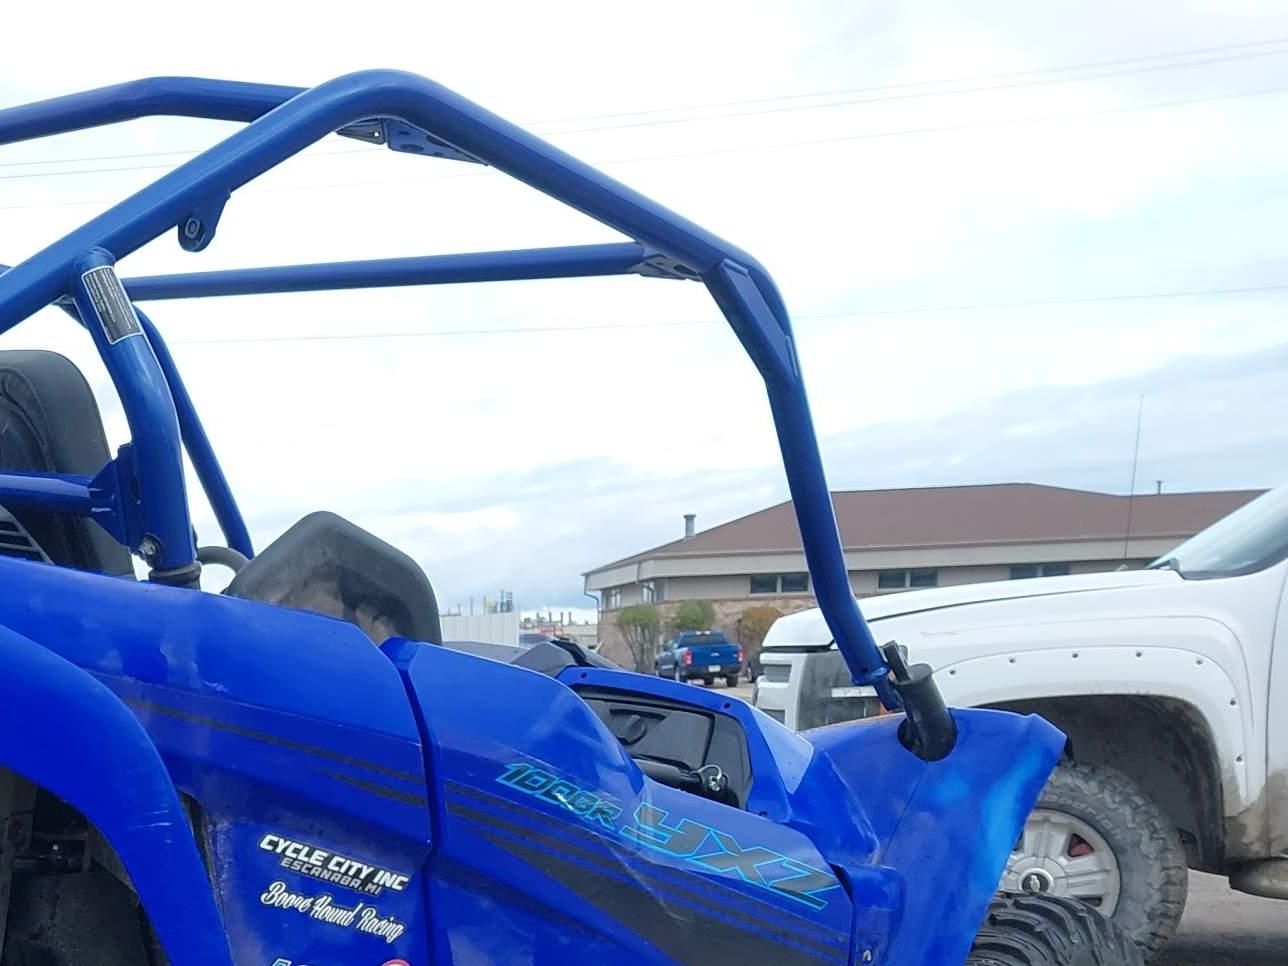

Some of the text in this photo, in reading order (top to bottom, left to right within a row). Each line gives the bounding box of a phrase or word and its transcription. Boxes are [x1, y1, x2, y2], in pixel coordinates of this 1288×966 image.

[260, 834, 409, 890] CYCLE CITY INC
[618, 802, 844, 910] YXZ
[364, 882, 382, 895] MI
[310, 895, 363, 927] Hound
[356, 907, 405, 943] Racing
